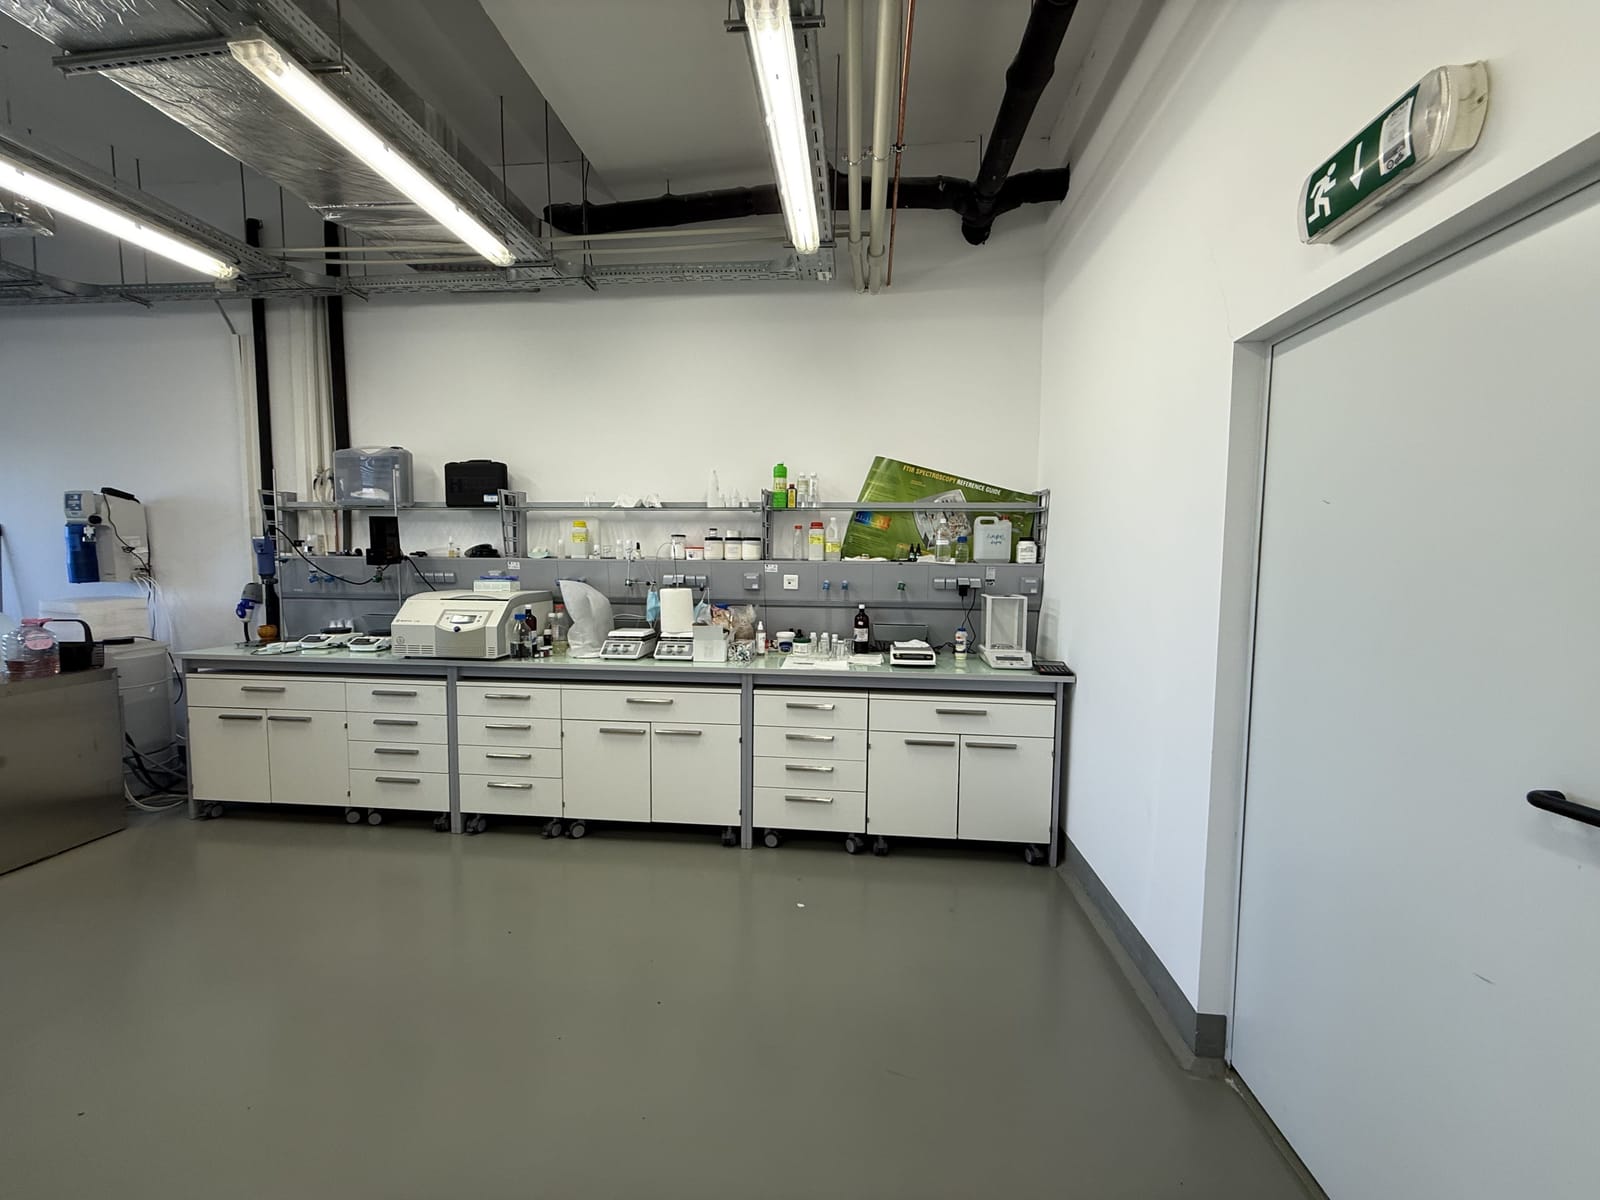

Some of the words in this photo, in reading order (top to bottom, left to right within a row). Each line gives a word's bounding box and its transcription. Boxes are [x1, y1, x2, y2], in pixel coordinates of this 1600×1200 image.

[903, 465, 914, 473] FTIR
[915, 468, 957, 483] SPECTROSCOPY
[956, 479, 985, 491] REFERENCE
[985, 487, 1001, 496] GUIDE
